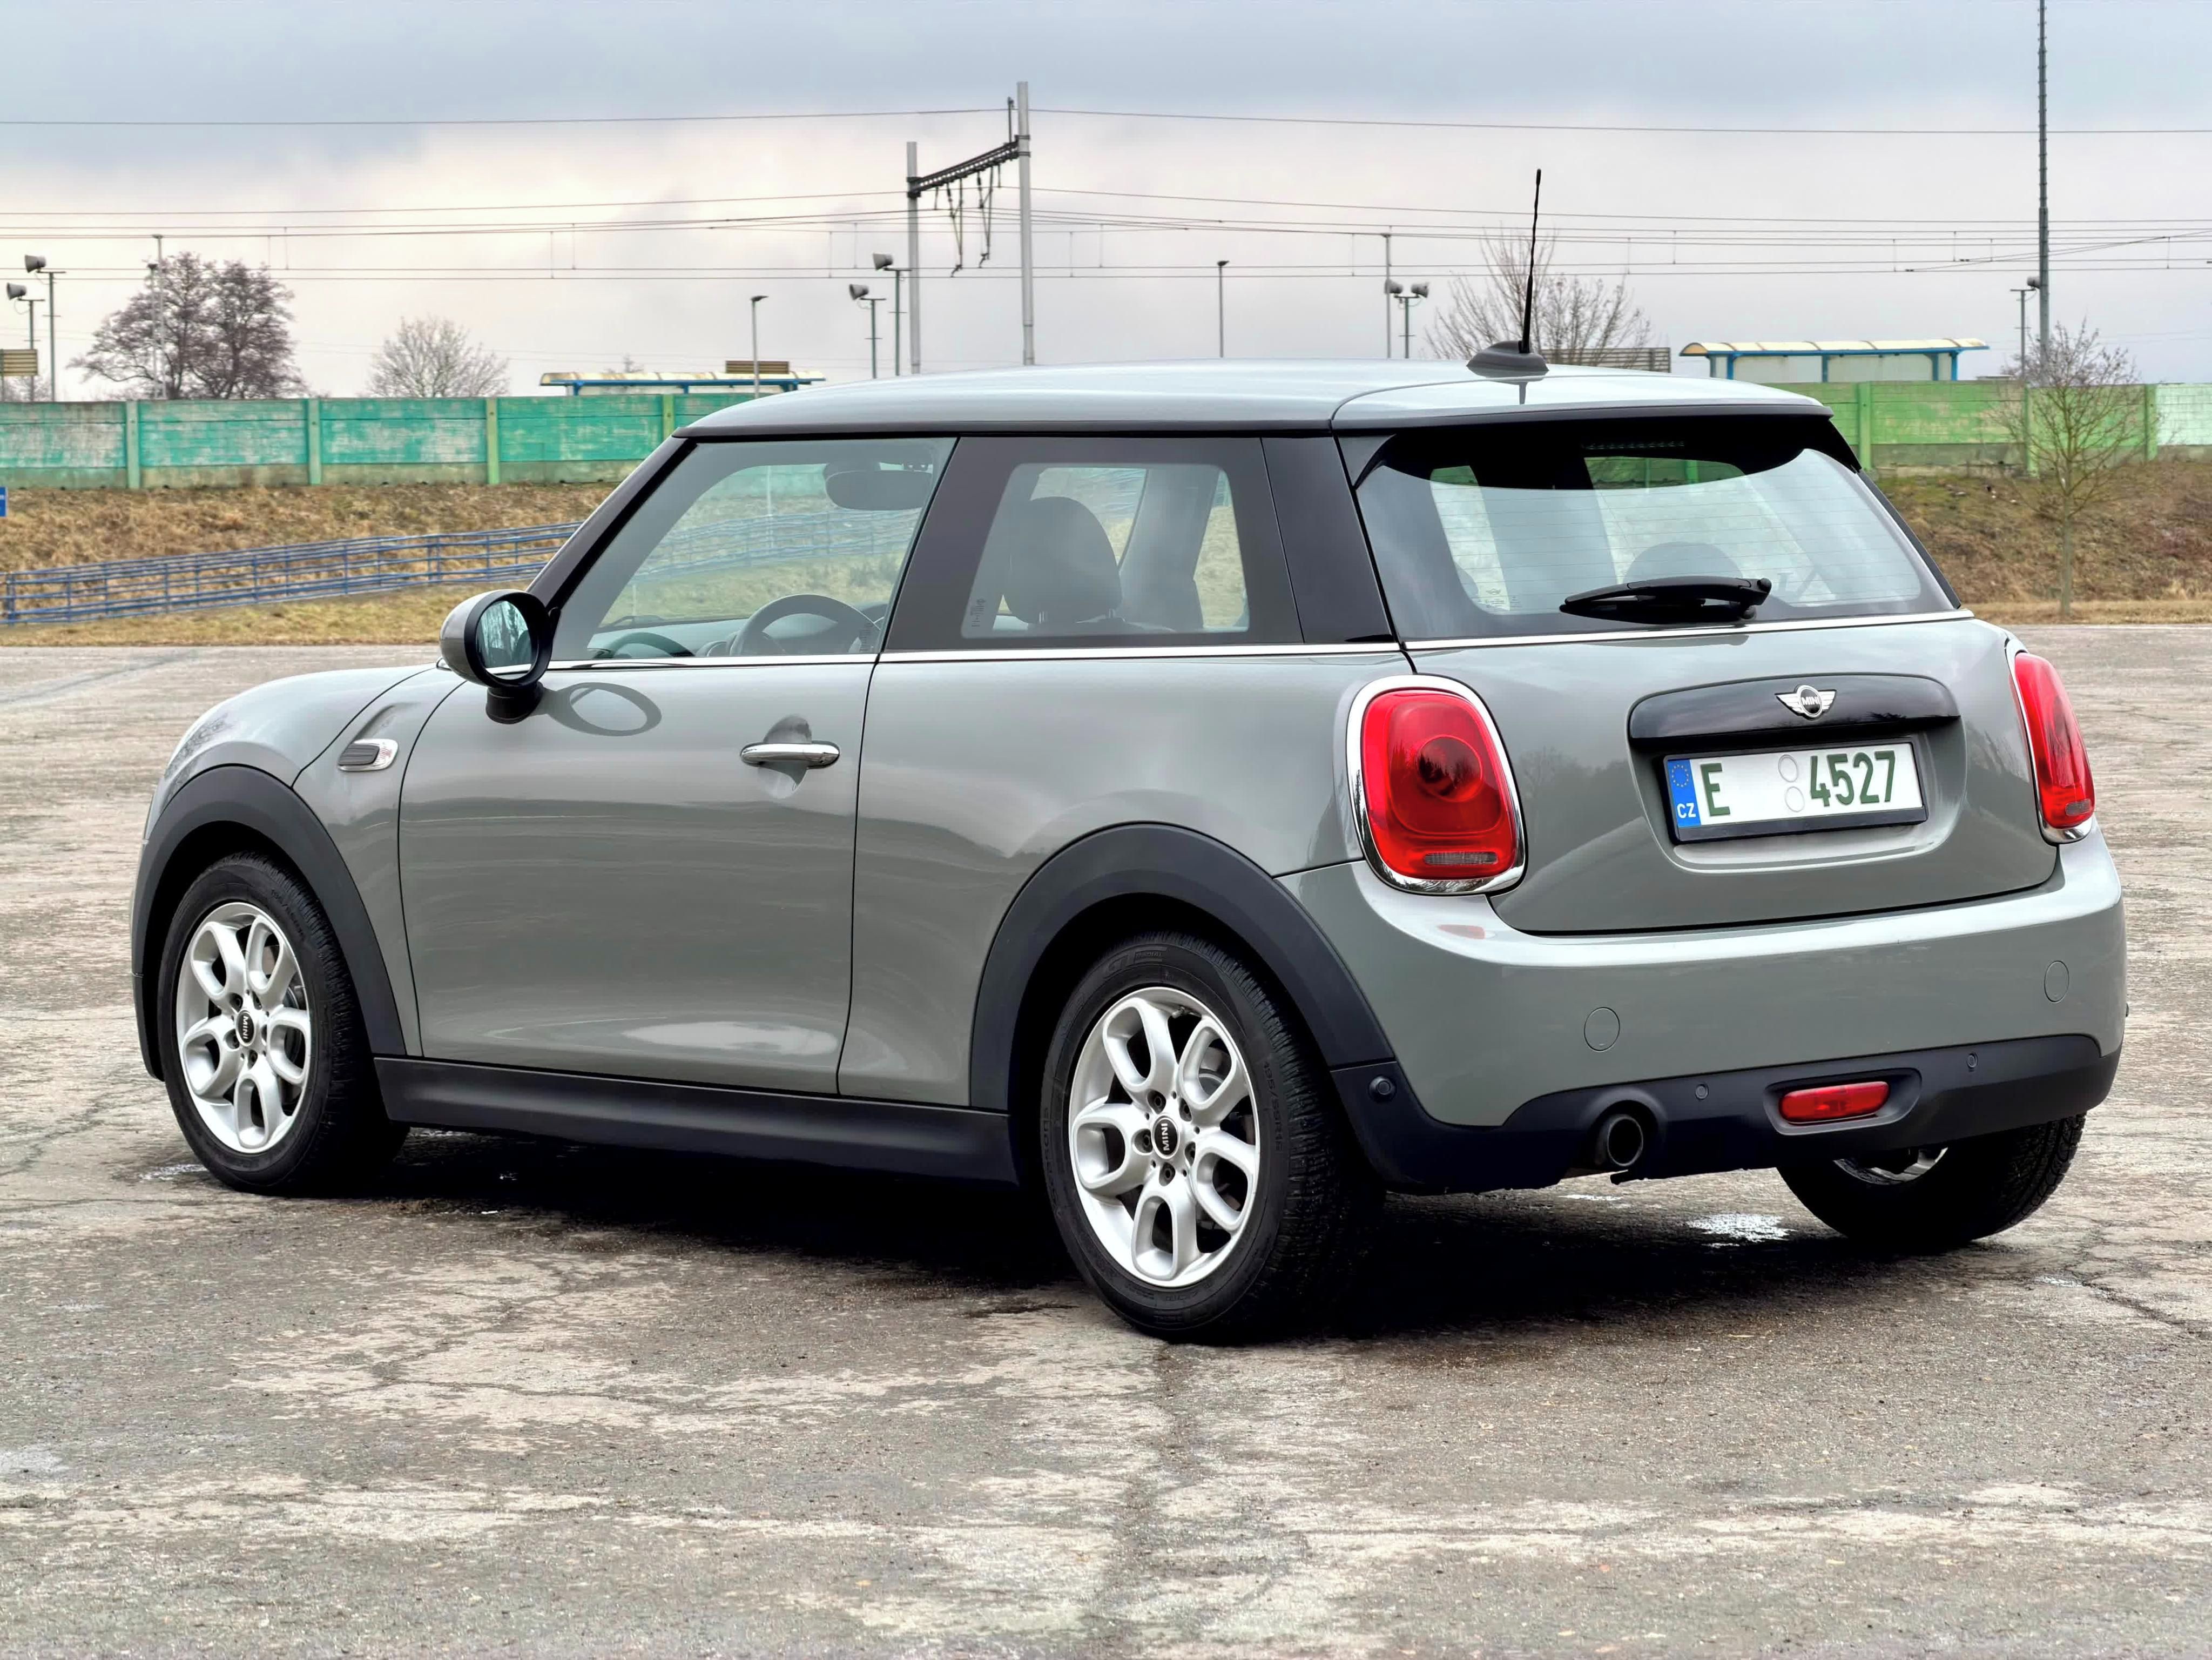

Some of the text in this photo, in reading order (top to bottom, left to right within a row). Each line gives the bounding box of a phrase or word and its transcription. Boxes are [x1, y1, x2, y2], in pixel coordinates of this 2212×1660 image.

[1801, 696, 1820, 705] MINI
[1700, 750, 1896, 817] E 4527
[1677, 802, 1696, 818] CZ
[1161, 1123, 1170, 1151] MINI
